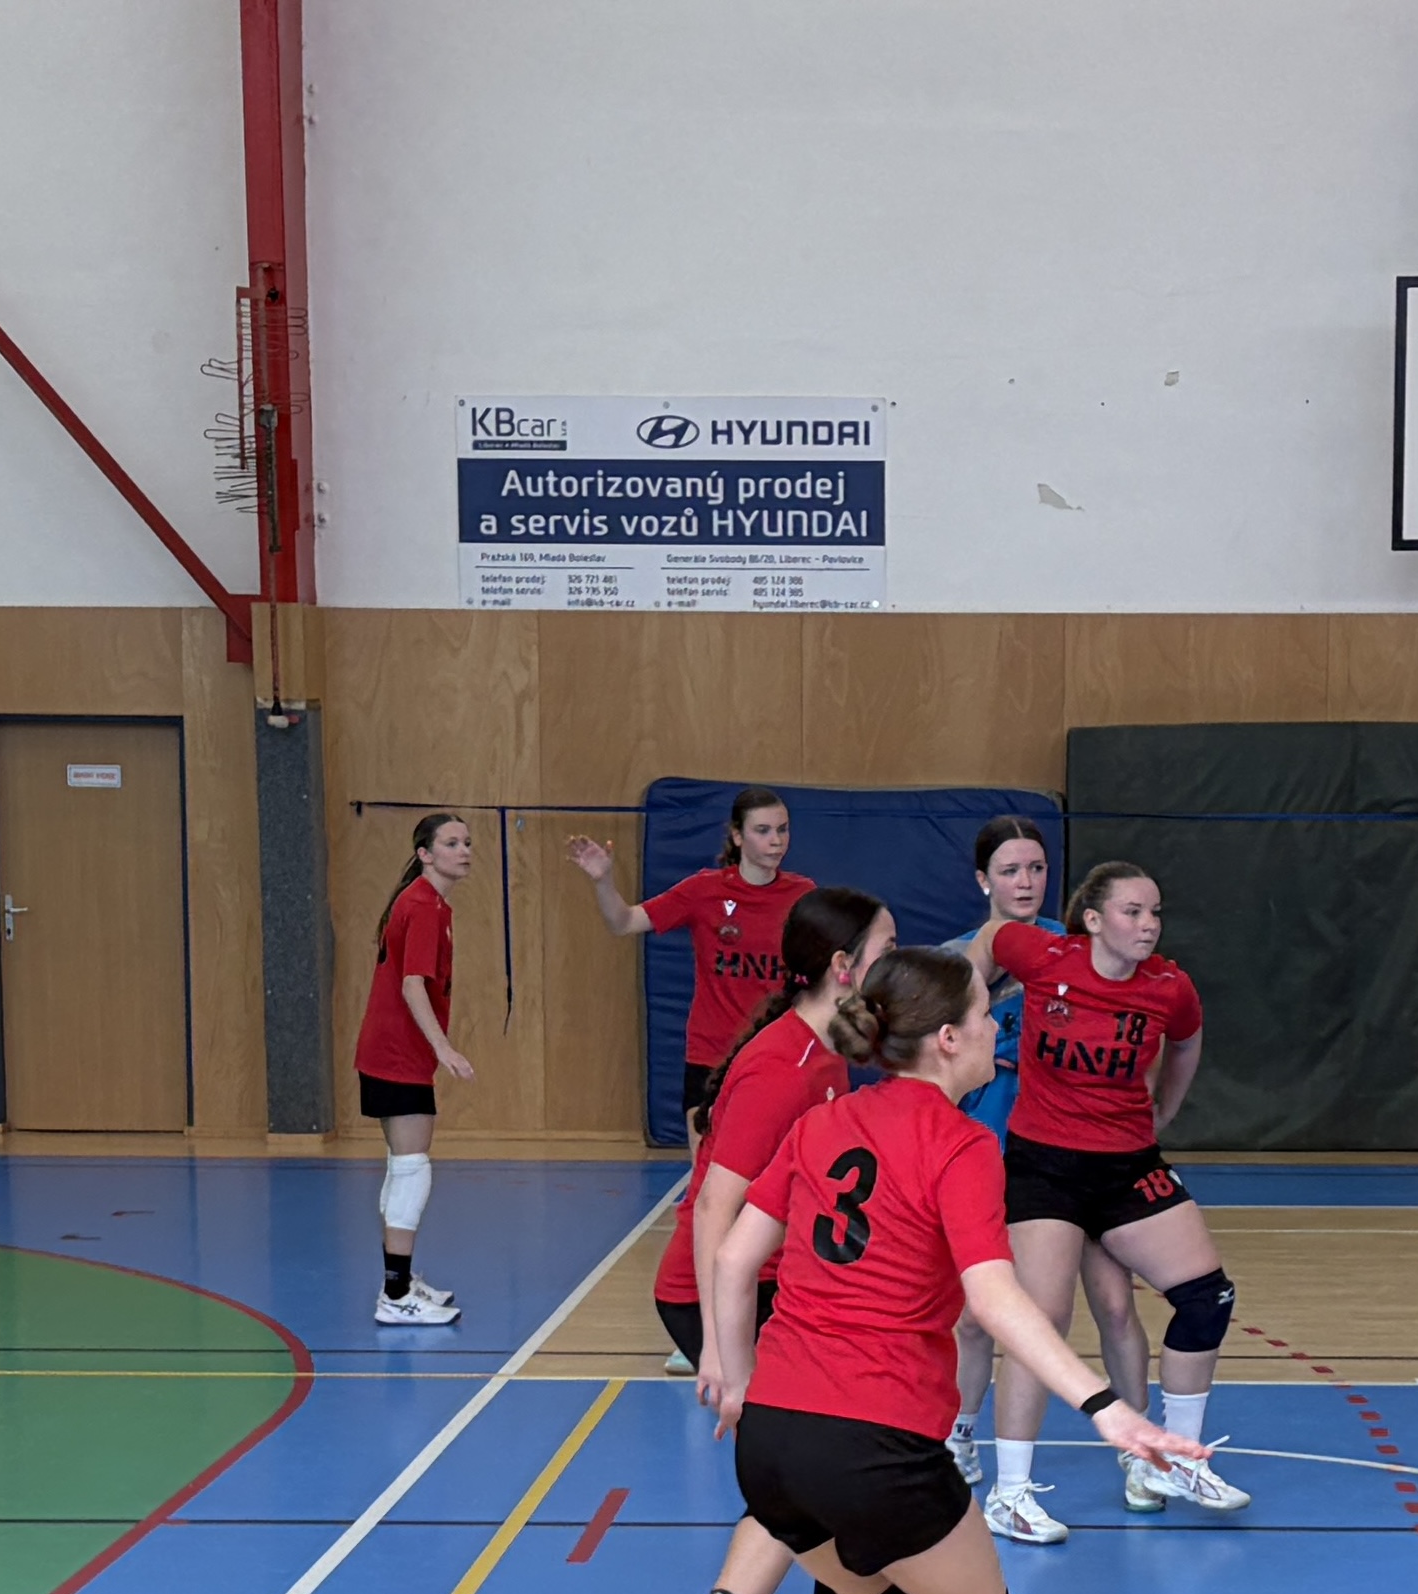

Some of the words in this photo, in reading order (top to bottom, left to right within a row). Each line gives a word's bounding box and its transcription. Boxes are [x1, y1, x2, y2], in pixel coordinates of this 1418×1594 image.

[471, 406, 558, 437] KBcar
[711, 420, 871, 447] HYUNDAI
[500, 469, 725, 506] Autorizovaný
[737, 471, 846, 504] prodej
[479, 514, 498, 536] a
[510, 509, 609, 536] servis
[621, 508, 700, 537] vozů
[712, 509, 869, 538] HYUNDAI
[1114, 1011, 1148, 1046] 18
[1036, 1031, 1138, 1080] HNH
[1134, 1169, 1176, 1204] 18
[812, 1146, 878, 1265] 3
